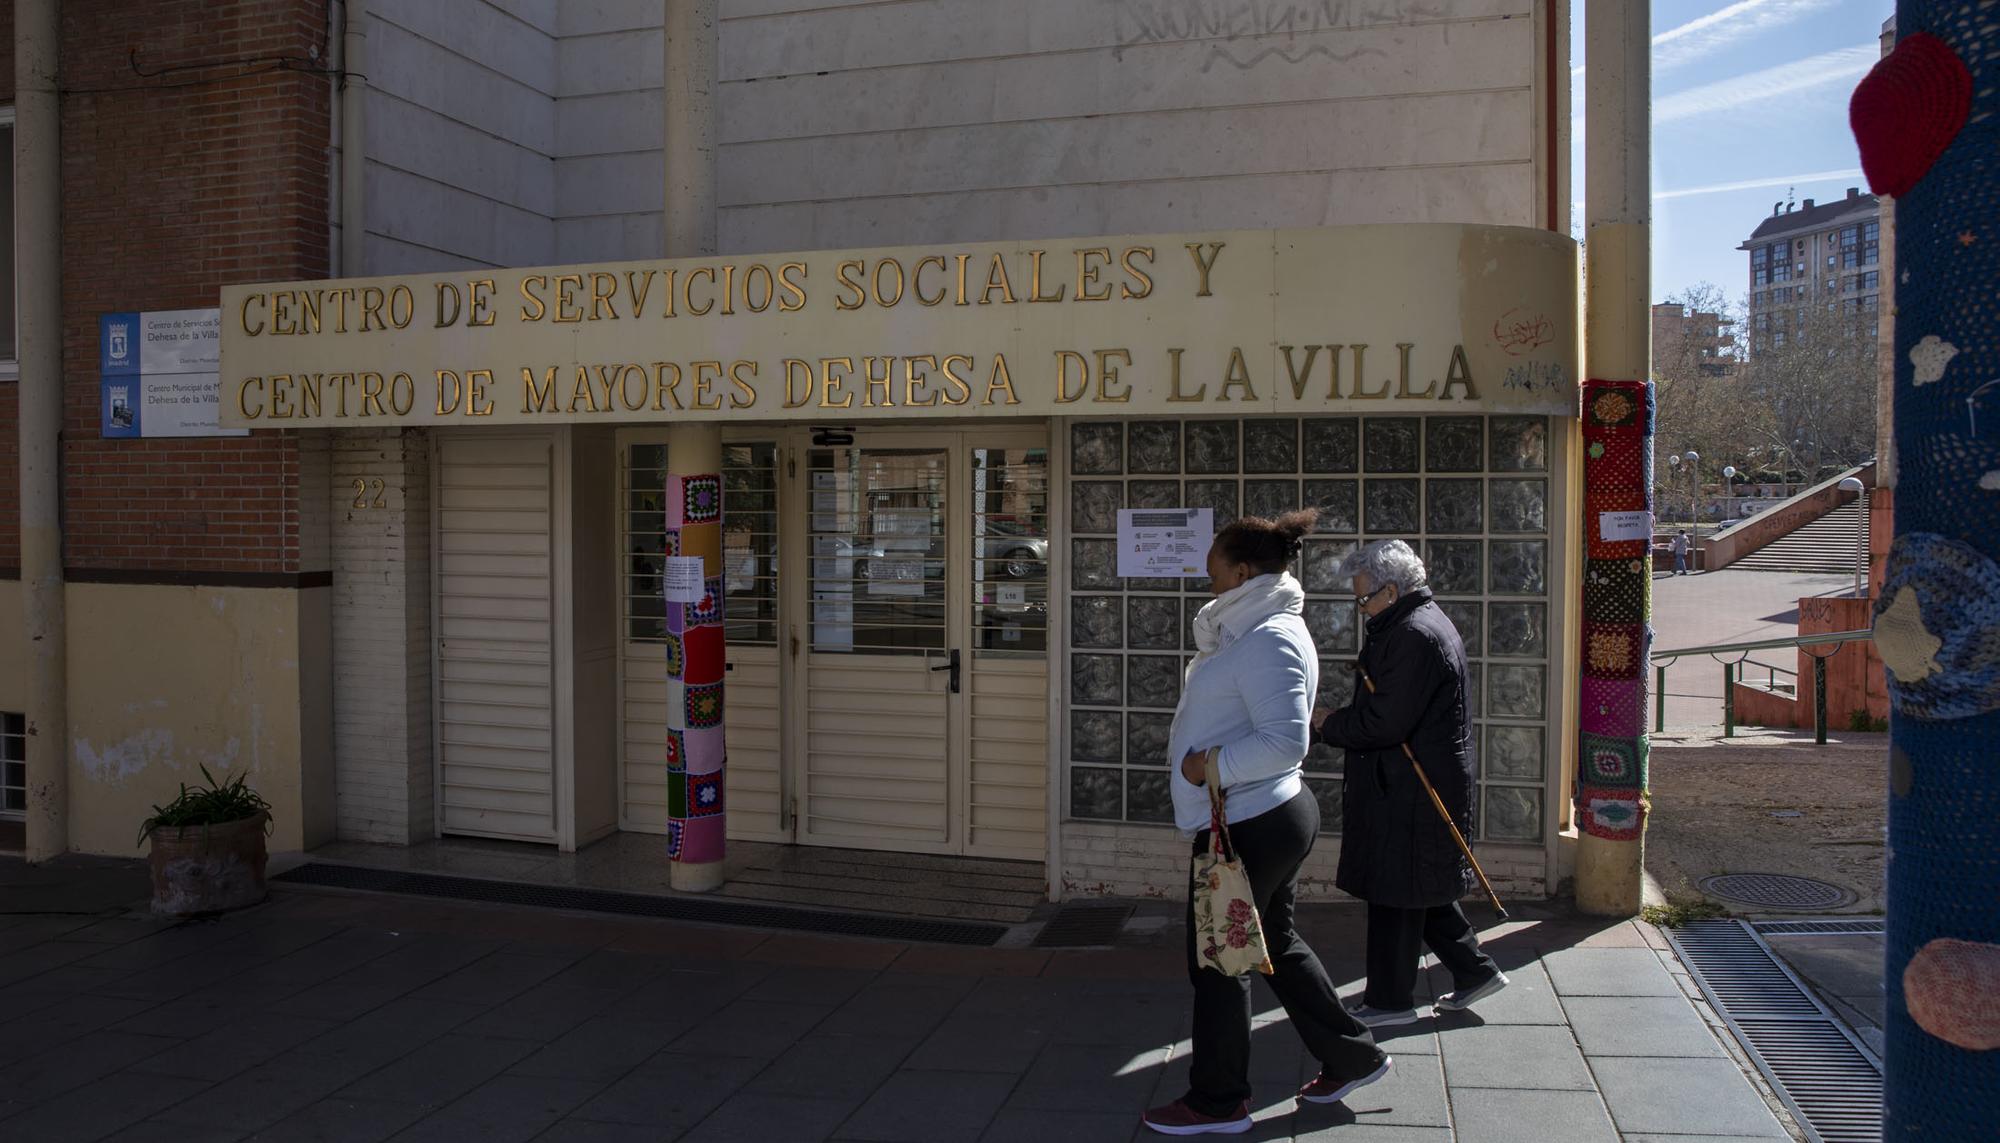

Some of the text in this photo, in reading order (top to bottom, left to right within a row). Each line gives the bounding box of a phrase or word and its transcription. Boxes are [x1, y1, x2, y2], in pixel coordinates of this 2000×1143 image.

[240, 241, 1226, 337] CENTRO DE SERVICIOS SOCIALES Y
[147, 321, 172, 330] Centro
[173, 320, 181, 328] de
[183, 319, 212, 328] Servicios
[147, 329, 219, 342] Dehesa de la Villa
[148, 384, 171, 393] Centro
[172, 383, 202, 393] Municipal
[203, 383, 212, 391] de
[236, 370, 415, 420] CENTRO
[434, 368, 495, 417] DE
[520, 360, 758, 414] MAYORES
[782, 352, 1022, 409] DEHESA
[1054, 348, 1133, 403] DE
[1166, 346, 1260, 402] LA
[1278, 343, 1482, 401] VILLA
[148, 394, 219, 405] Dehesa de la Villa
[352, 478, 387, 509] 22
